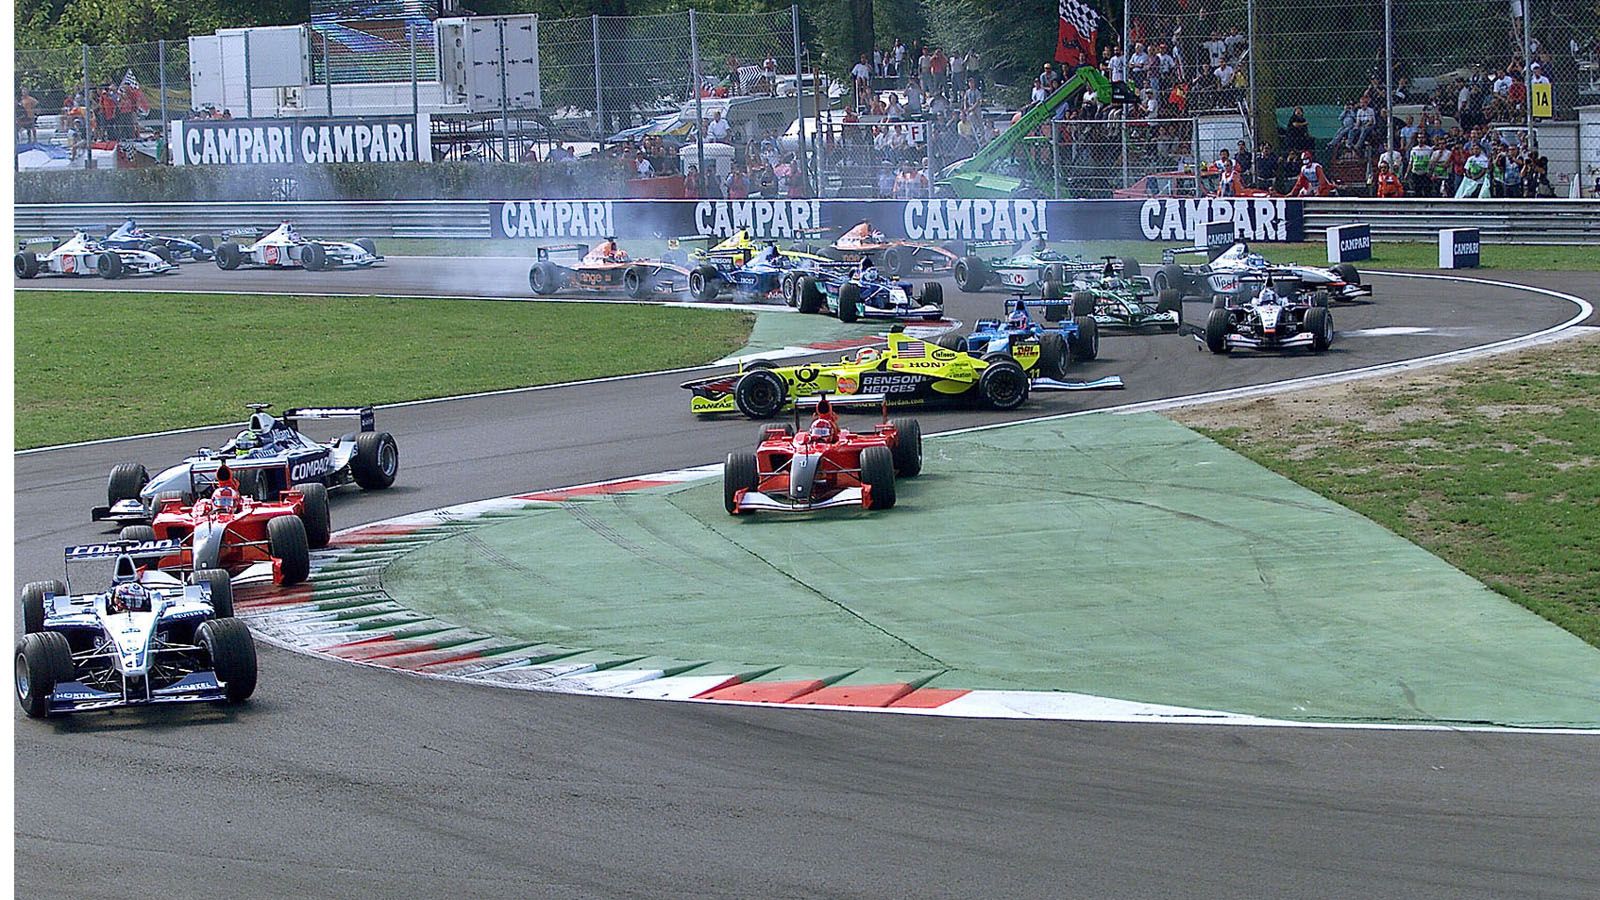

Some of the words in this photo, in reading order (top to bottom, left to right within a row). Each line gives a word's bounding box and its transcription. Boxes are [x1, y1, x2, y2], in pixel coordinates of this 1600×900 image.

[1536, 92, 1548, 106] 1A
[186, 127, 293, 165] CAMPARI
[302, 123, 414, 164] CAMPARI
[501, 200, 614, 238] CAMPARI
[695, 200, 820, 239] CAMPARI
[904, 199, 1048, 240] CAMPARI
[1140, 199, 1287, 241] CAMPARI
[1207, 232, 1234, 246] CAMPARI
[1340, 236, 1370, 252] CAMPARI
[1453, 242, 1480, 256] CAMPARI
[1213, 276, 1236, 290] West
[863, 375, 921, 385] BENSON
[862, 384, 916, 394] HEDGES
[693, 402, 732, 410] DANZAS
[291, 457, 329, 481] COMPAQ
